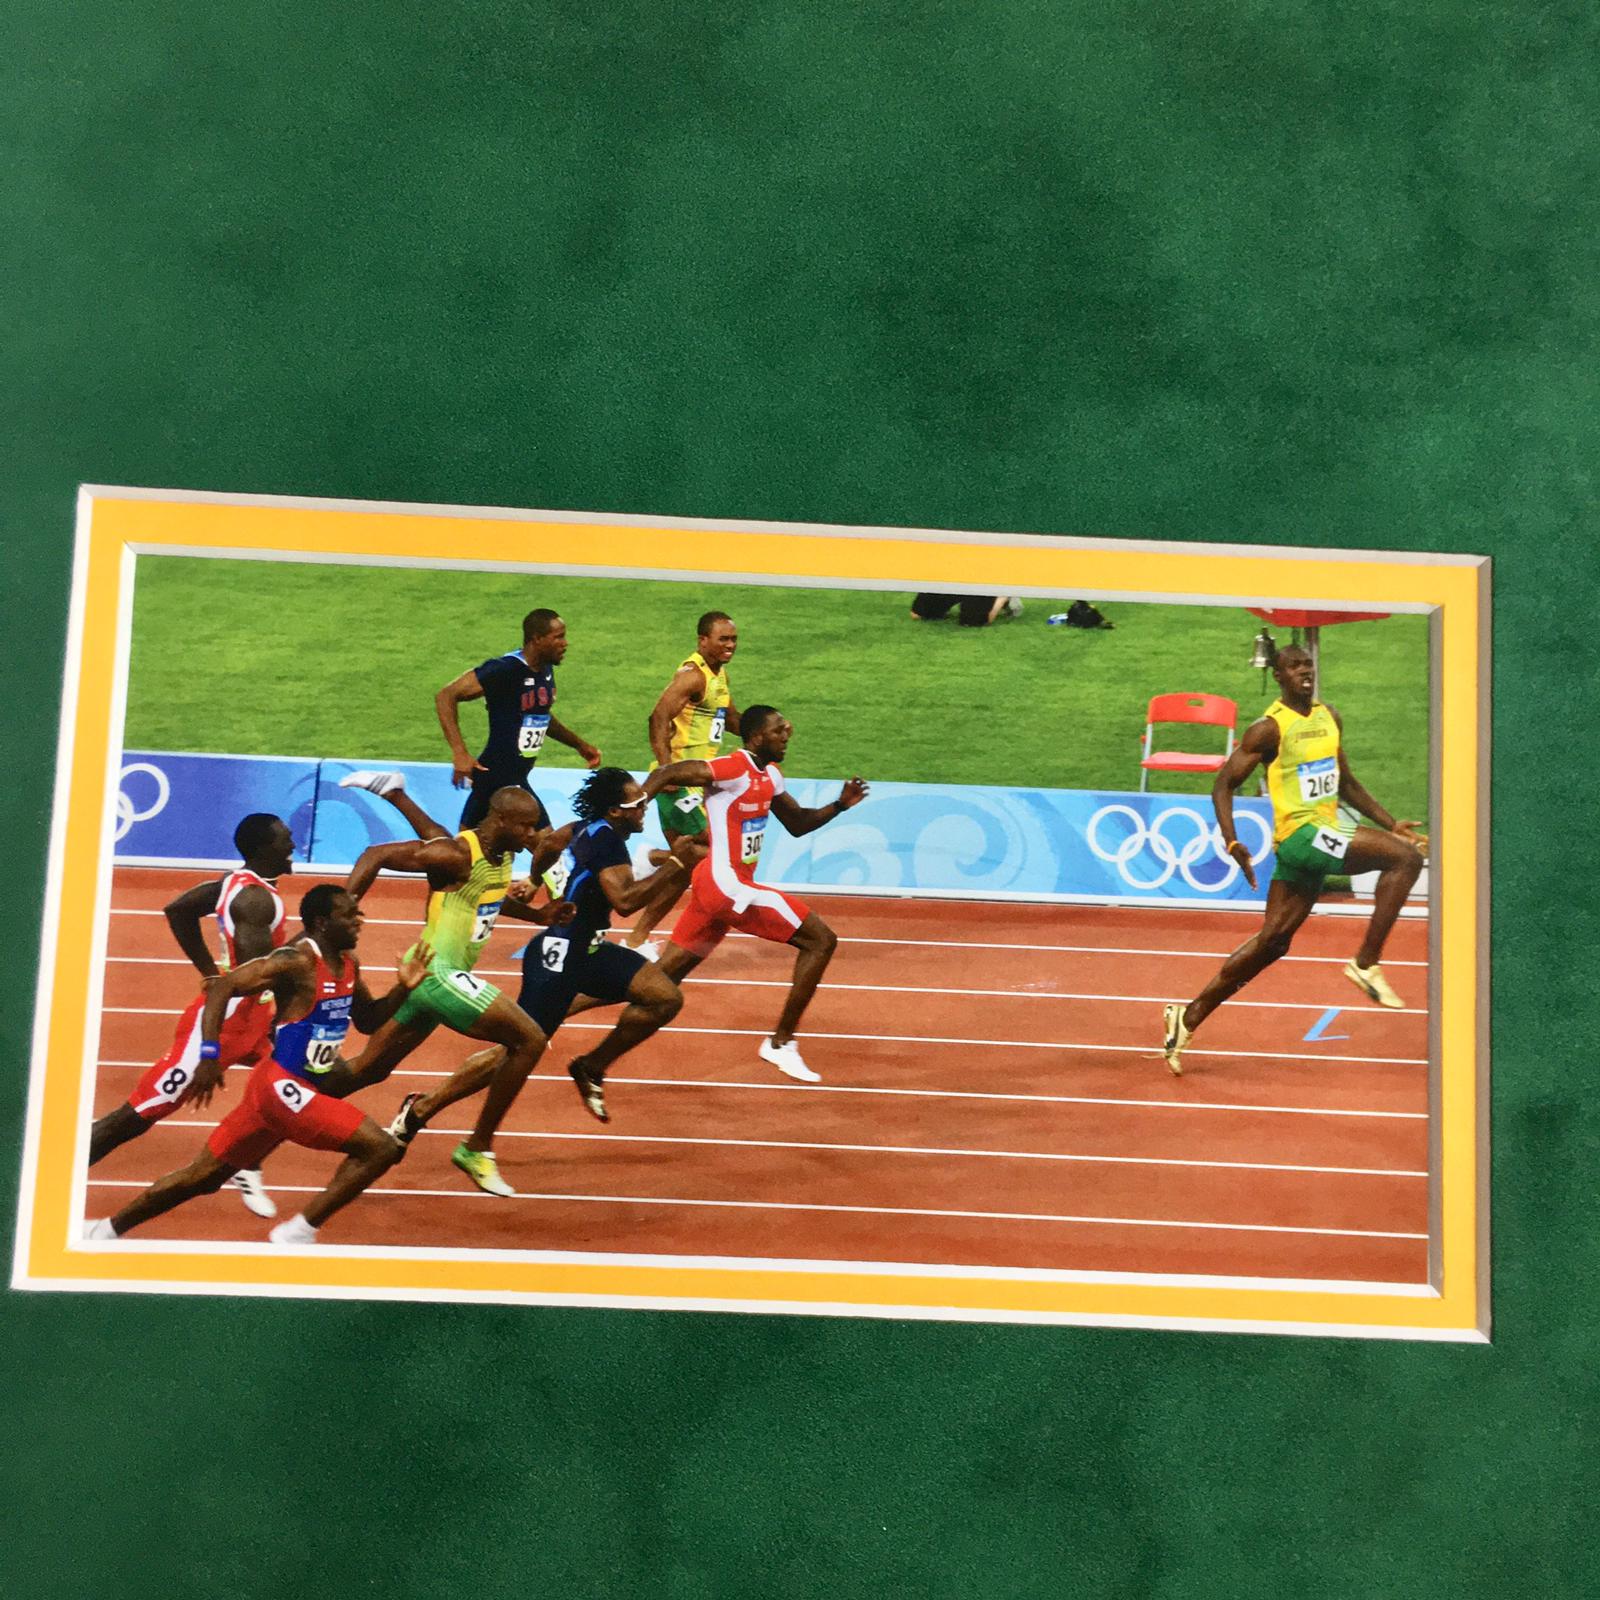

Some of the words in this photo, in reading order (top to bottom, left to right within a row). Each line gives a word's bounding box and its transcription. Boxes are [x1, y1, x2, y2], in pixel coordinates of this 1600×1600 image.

[1321, 833, 1342, 851] 4
[544, 941, 561, 968] 6
[456, 972, 478, 990] 7
[162, 1067, 187, 1095] 8
[282, 1082, 302, 1105] 9
